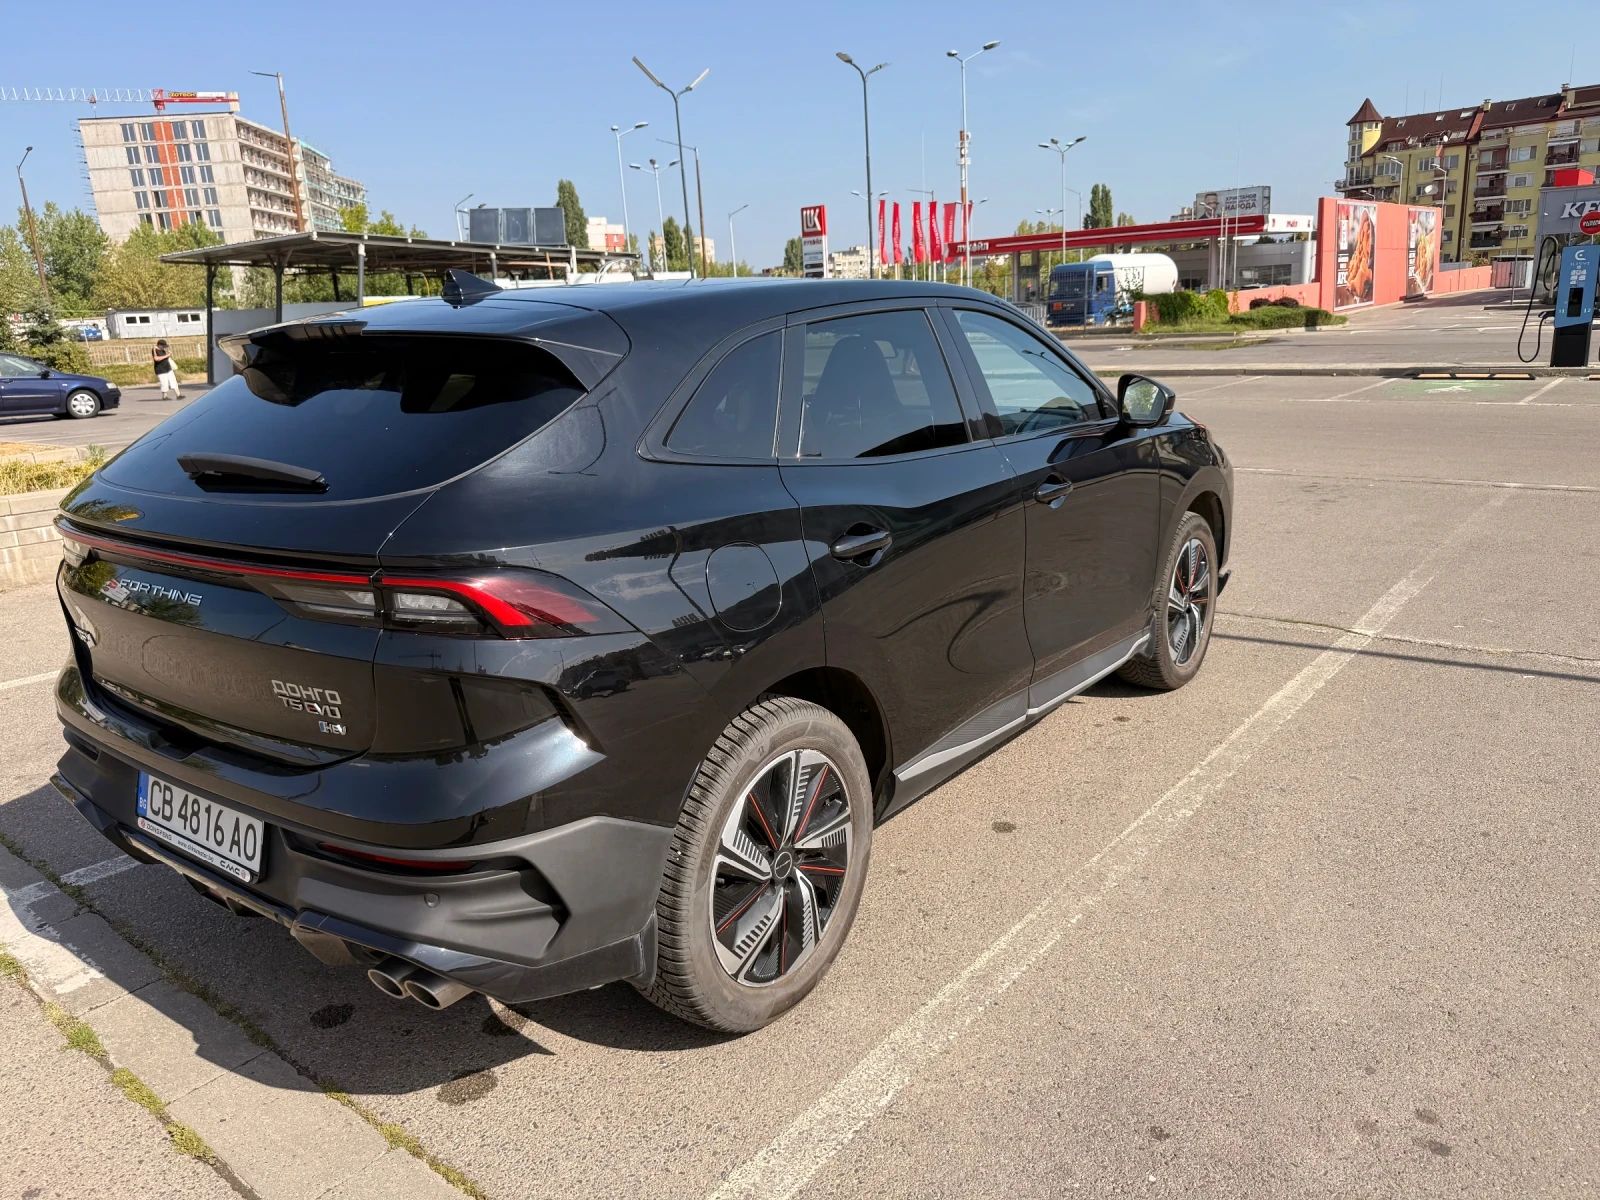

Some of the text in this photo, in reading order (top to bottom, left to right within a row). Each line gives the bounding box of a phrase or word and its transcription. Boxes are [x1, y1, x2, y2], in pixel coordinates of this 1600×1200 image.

[1560, 200, 1600, 218] KF
[120, 579, 202, 606] FORTHING
[271, 679, 341, 704] ДОНГО
[304, 701, 341, 719] EVO
[139, 796, 147, 809] BG
[178, 794, 225, 847] 4816
[146, 823, 172, 841] DONGFENG
[219, 860, 240, 876] CMC
